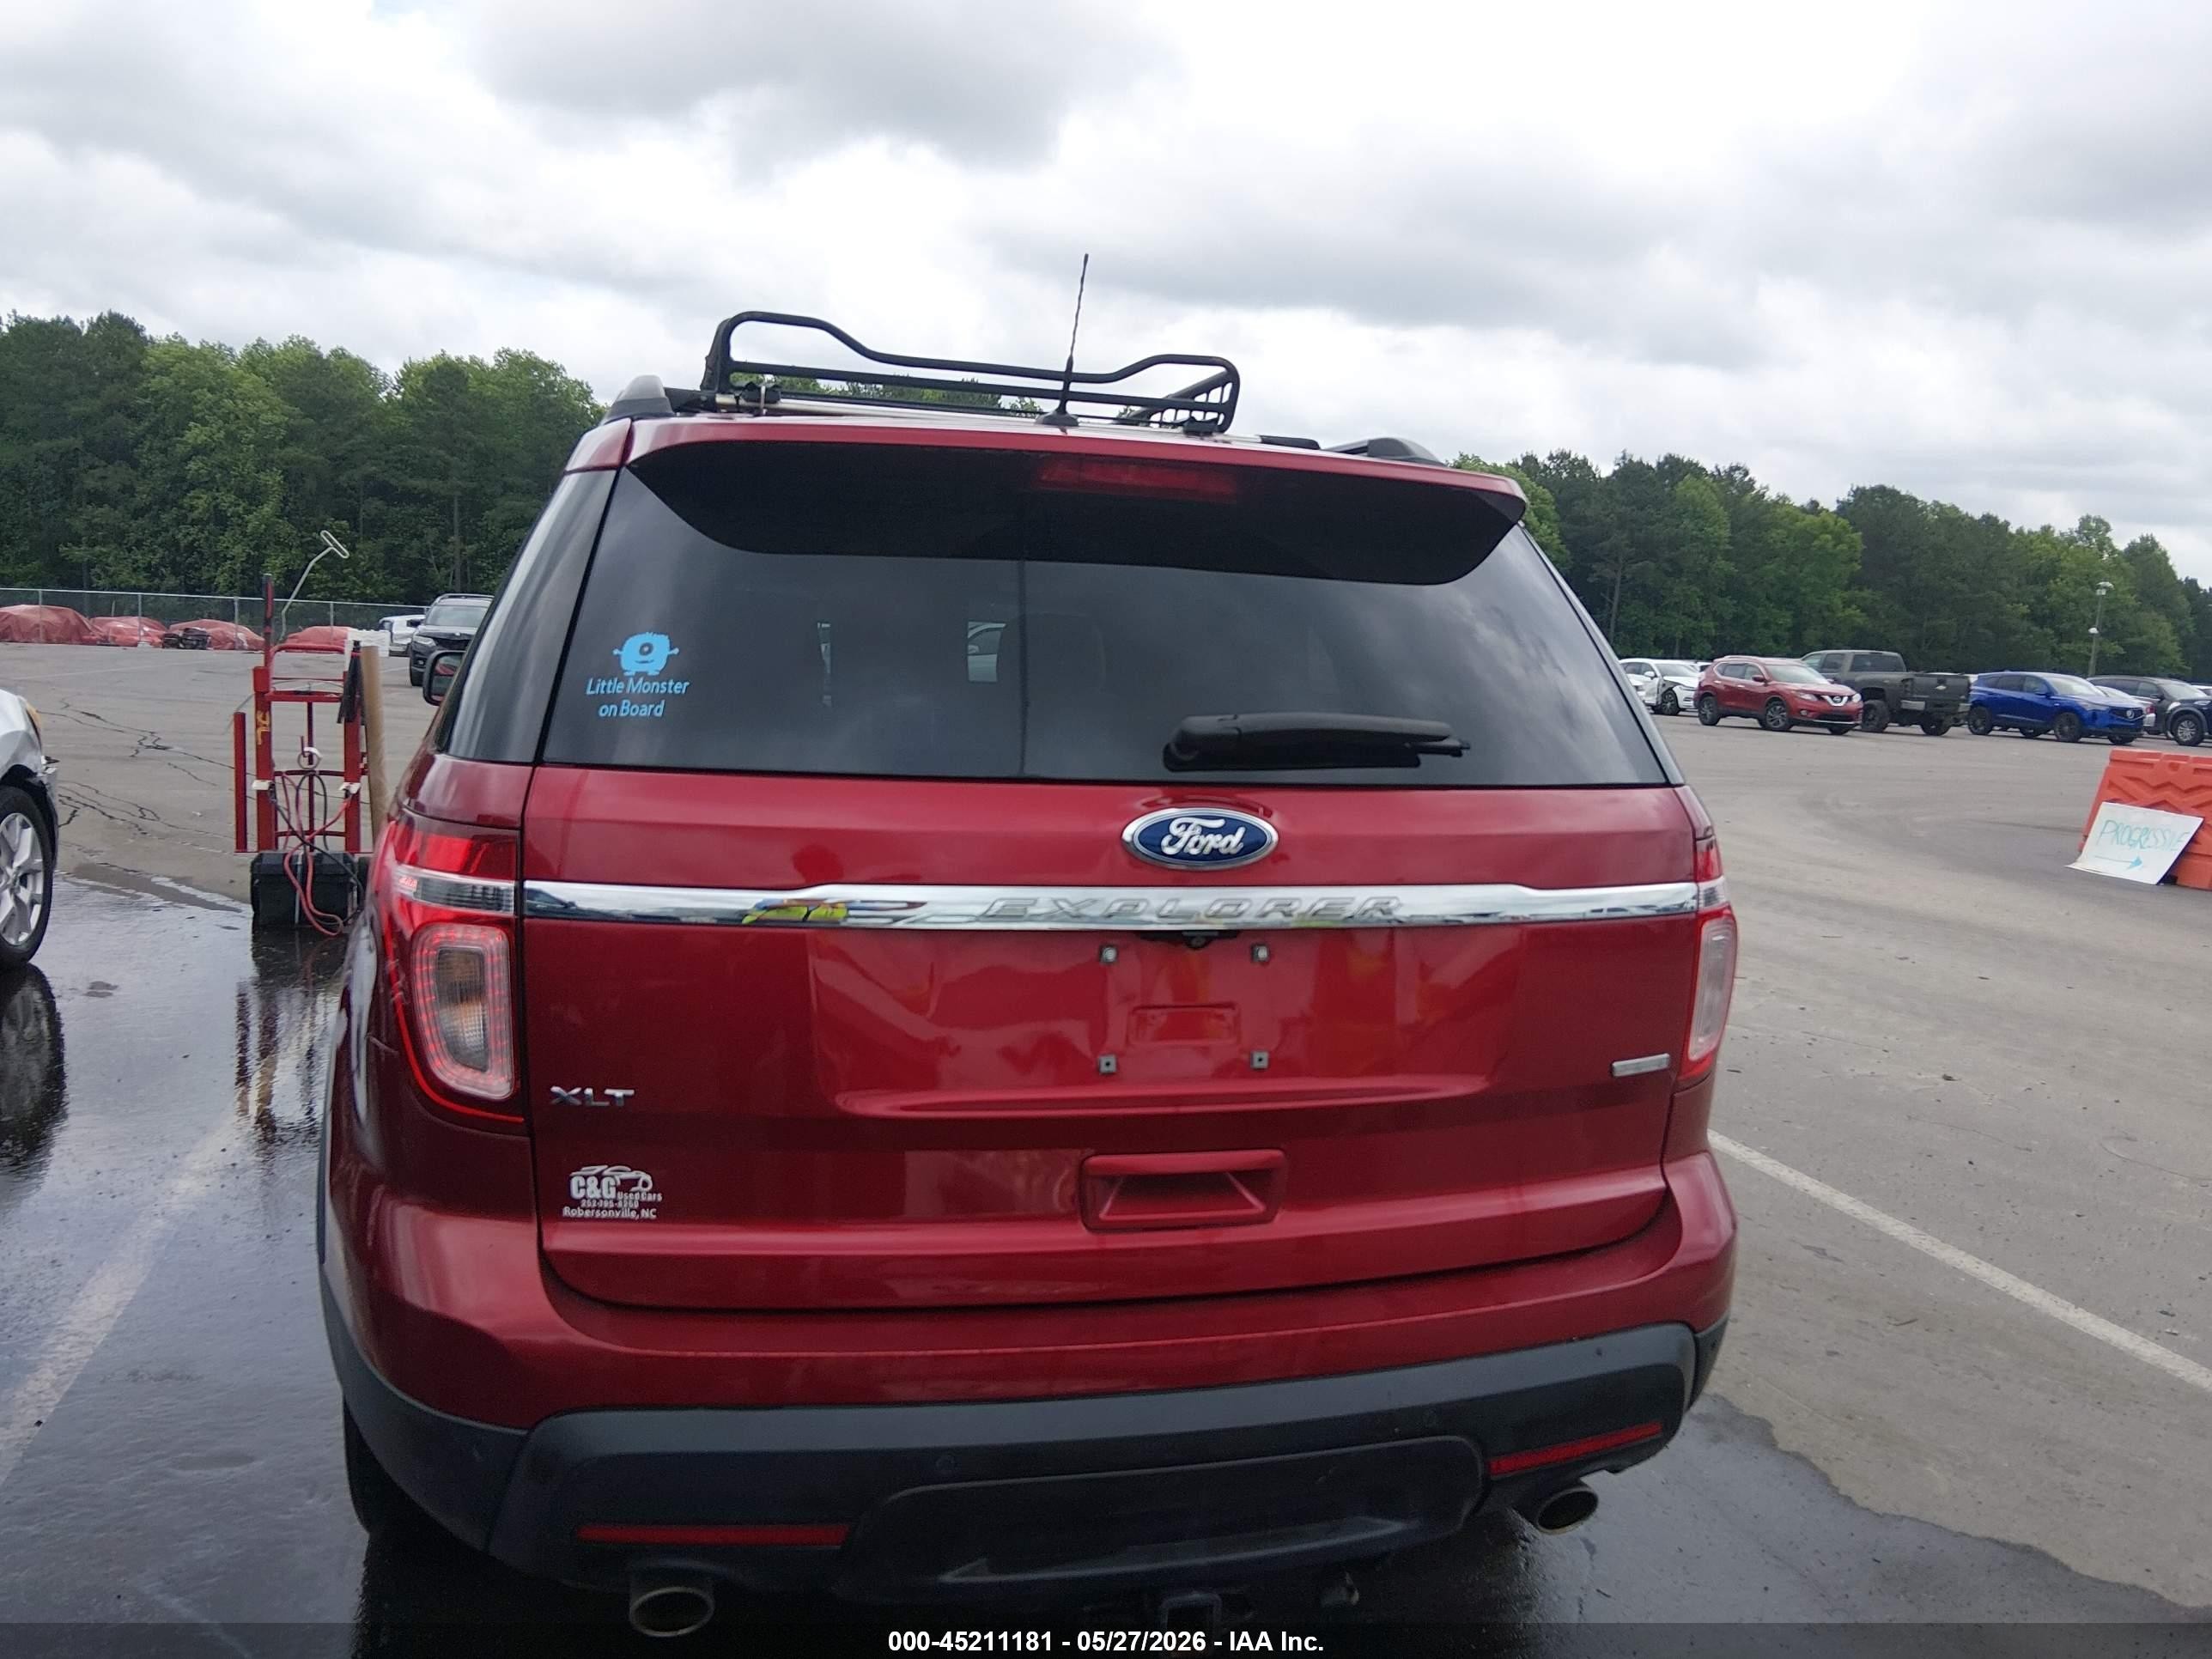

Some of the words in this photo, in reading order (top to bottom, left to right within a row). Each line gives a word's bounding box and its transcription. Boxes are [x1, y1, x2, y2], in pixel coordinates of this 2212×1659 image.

[586, 677, 624, 696] Little
[626, 677, 690, 696] Monster
[599, 703, 617, 718] on
[620, 699, 665, 718] Board
[1160, 817, 1246, 855] Ford
[978, 896, 1406, 923] EXPLORER
[550, 1085, 635, 1107] XLT
[570, 1176, 617, 1200] C&G
[617, 1191, 640, 1200] Used
[641, 1192, 663, 1202] Cars
[562, 1206, 640, 1219] Robersonville,
[641, 1208, 657, 1218] NC
